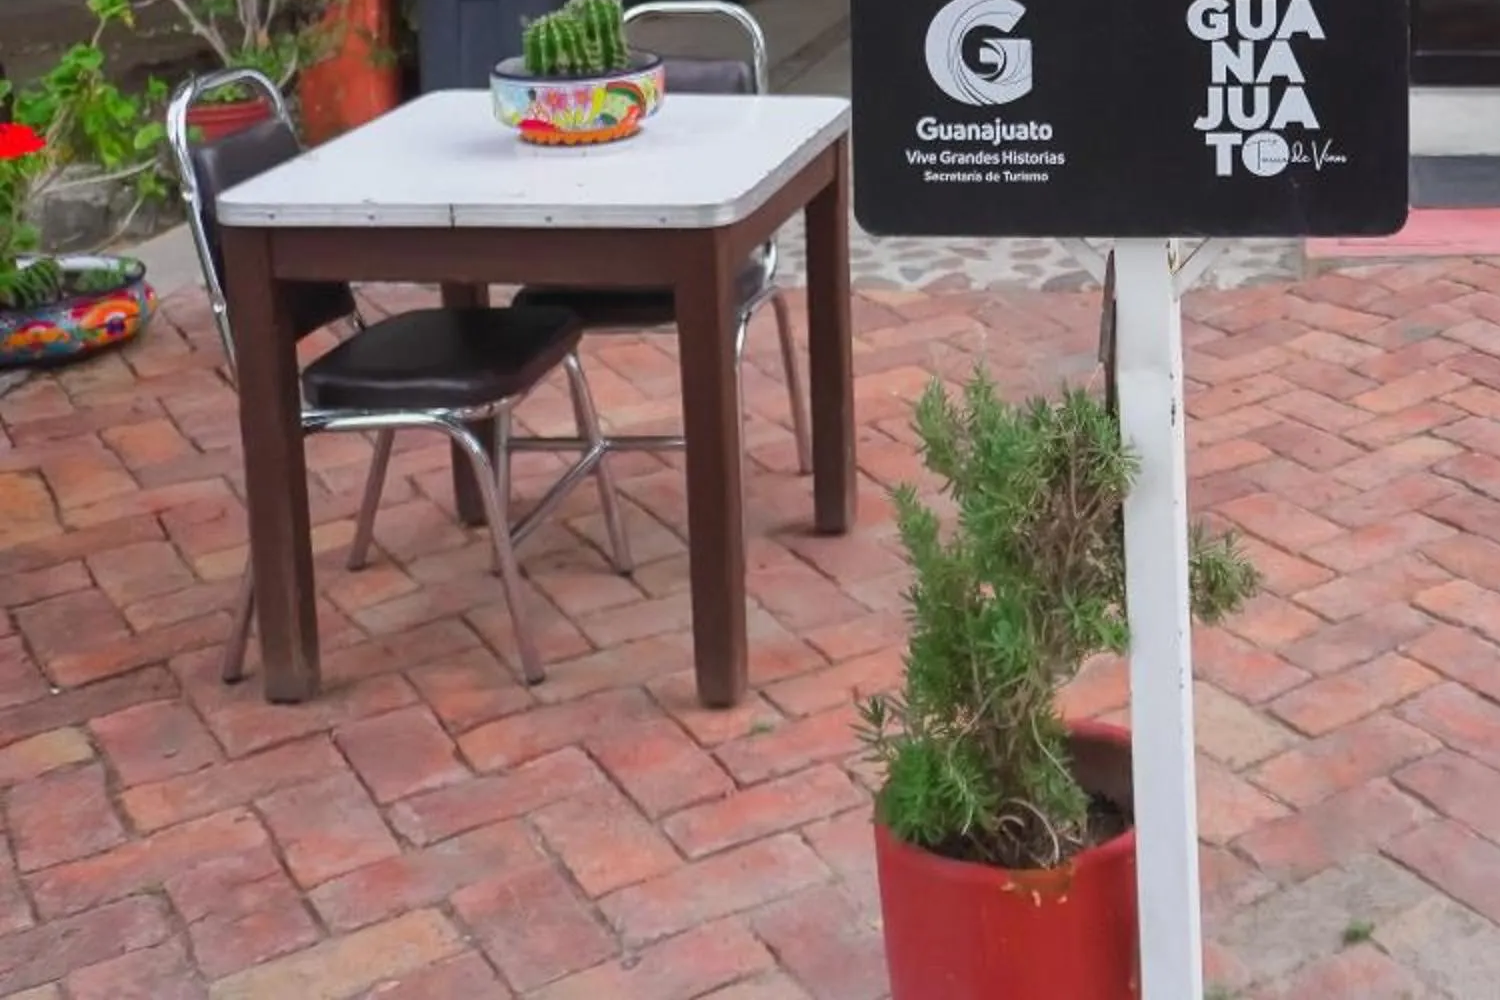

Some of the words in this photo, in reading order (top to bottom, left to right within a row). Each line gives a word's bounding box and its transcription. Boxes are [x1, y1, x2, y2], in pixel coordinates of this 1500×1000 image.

[916, 116, 1053, 146] Guanajuato
[905, 149, 937, 165] Vive
[939, 150, 1001, 165] Grandes
[1001, 150, 1065, 165] Historias
[985, 171, 1001, 183] de
[1003, 170, 1049, 183] Turismo
